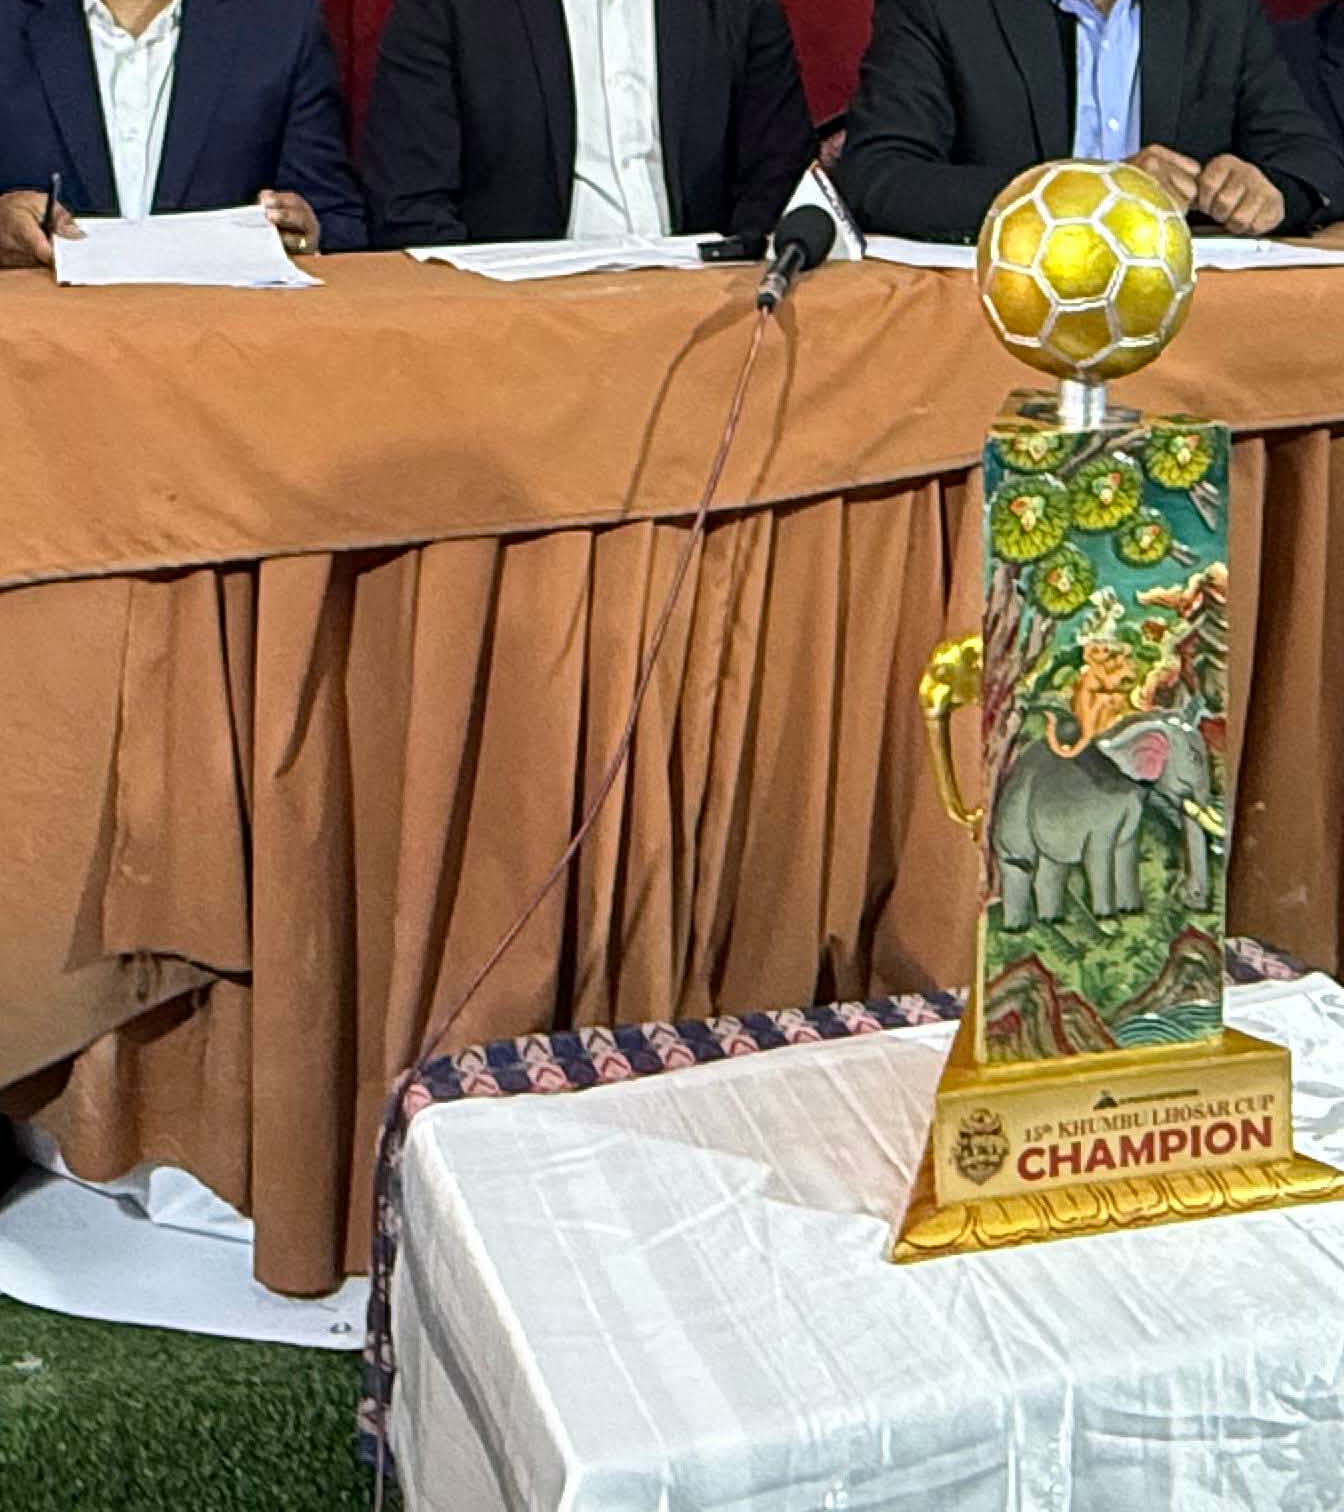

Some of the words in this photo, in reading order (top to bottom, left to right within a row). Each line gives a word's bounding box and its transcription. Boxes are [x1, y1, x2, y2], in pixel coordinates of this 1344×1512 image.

[1058, 1110, 1150, 1138] KHUMBU
[1151, 1102, 1231, 1127] LHOSAR
[1235, 1094, 1275, 1115] CUP
[1017, 1116, 1273, 1181] CHAMPION
